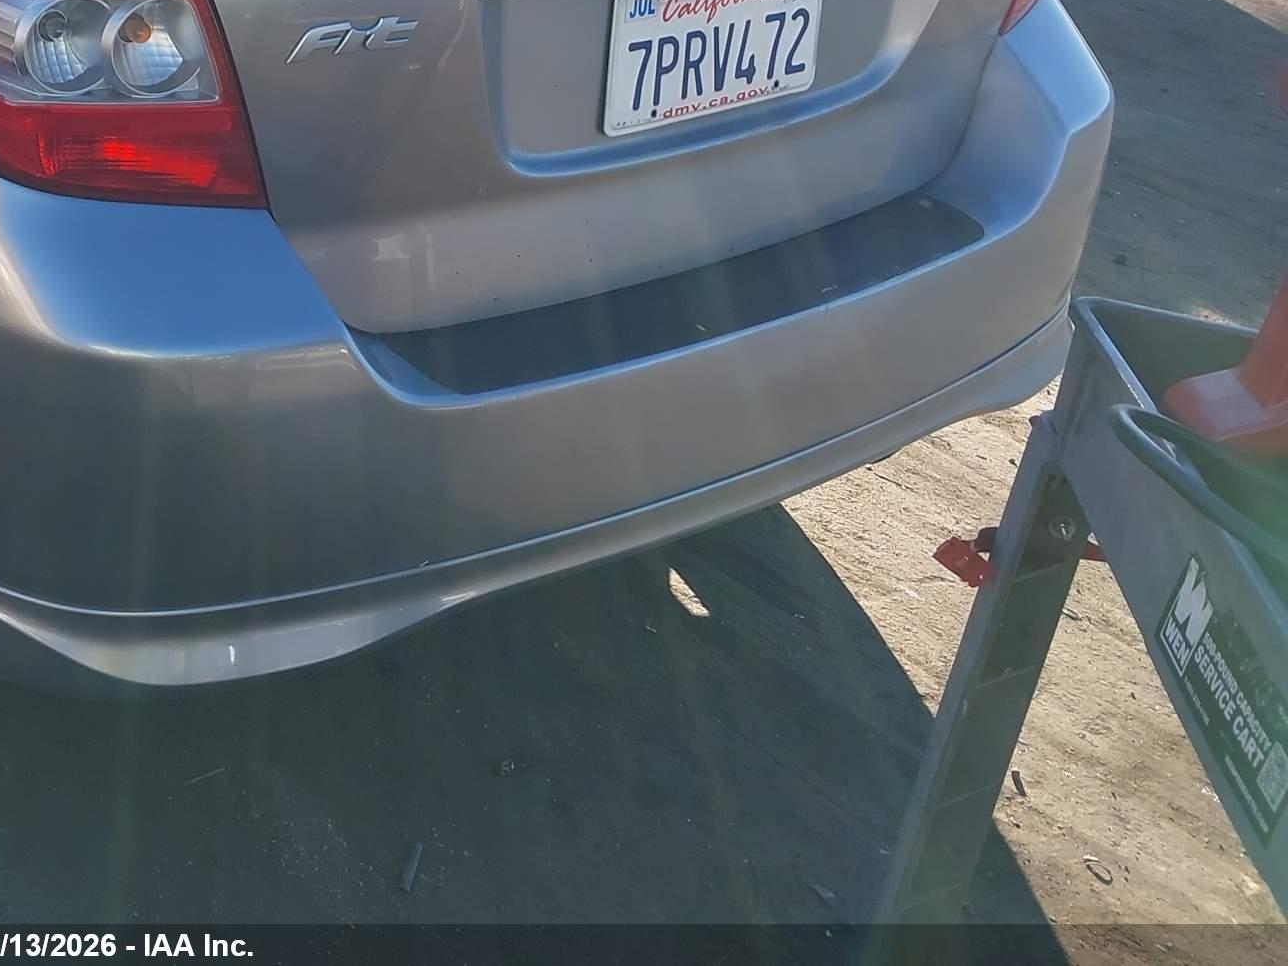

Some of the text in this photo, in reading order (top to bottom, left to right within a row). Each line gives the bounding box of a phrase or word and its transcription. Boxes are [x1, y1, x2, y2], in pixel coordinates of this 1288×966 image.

[628, 7, 810, 112] 7PRV472
[1165, 616, 1190, 667] WEN
[1194, 645, 1237, 721] SERVICE
[1232, 716, 1265, 768] CART
[1236, 692, 1272, 751] CAPACITY
